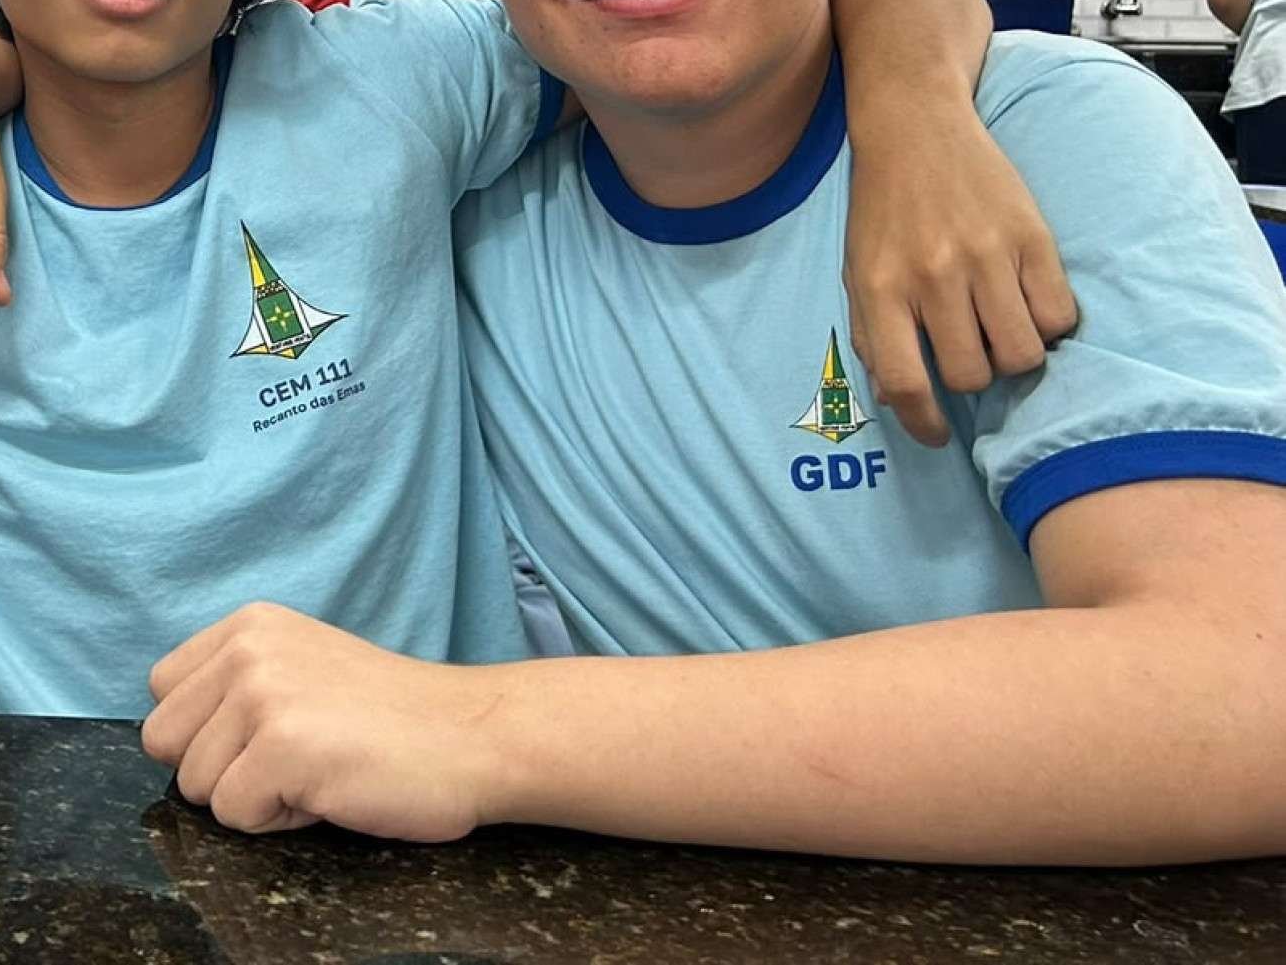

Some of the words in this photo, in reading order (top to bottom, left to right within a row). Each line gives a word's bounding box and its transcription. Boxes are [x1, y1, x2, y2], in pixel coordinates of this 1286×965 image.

[252, 403, 307, 433] Recanto
[310, 393, 335, 409] das
[336, 381, 366, 401] Emas
[259, 374, 312, 408] CEM
[315, 358, 353, 386] 111
[790, 450, 886, 492] GDF
